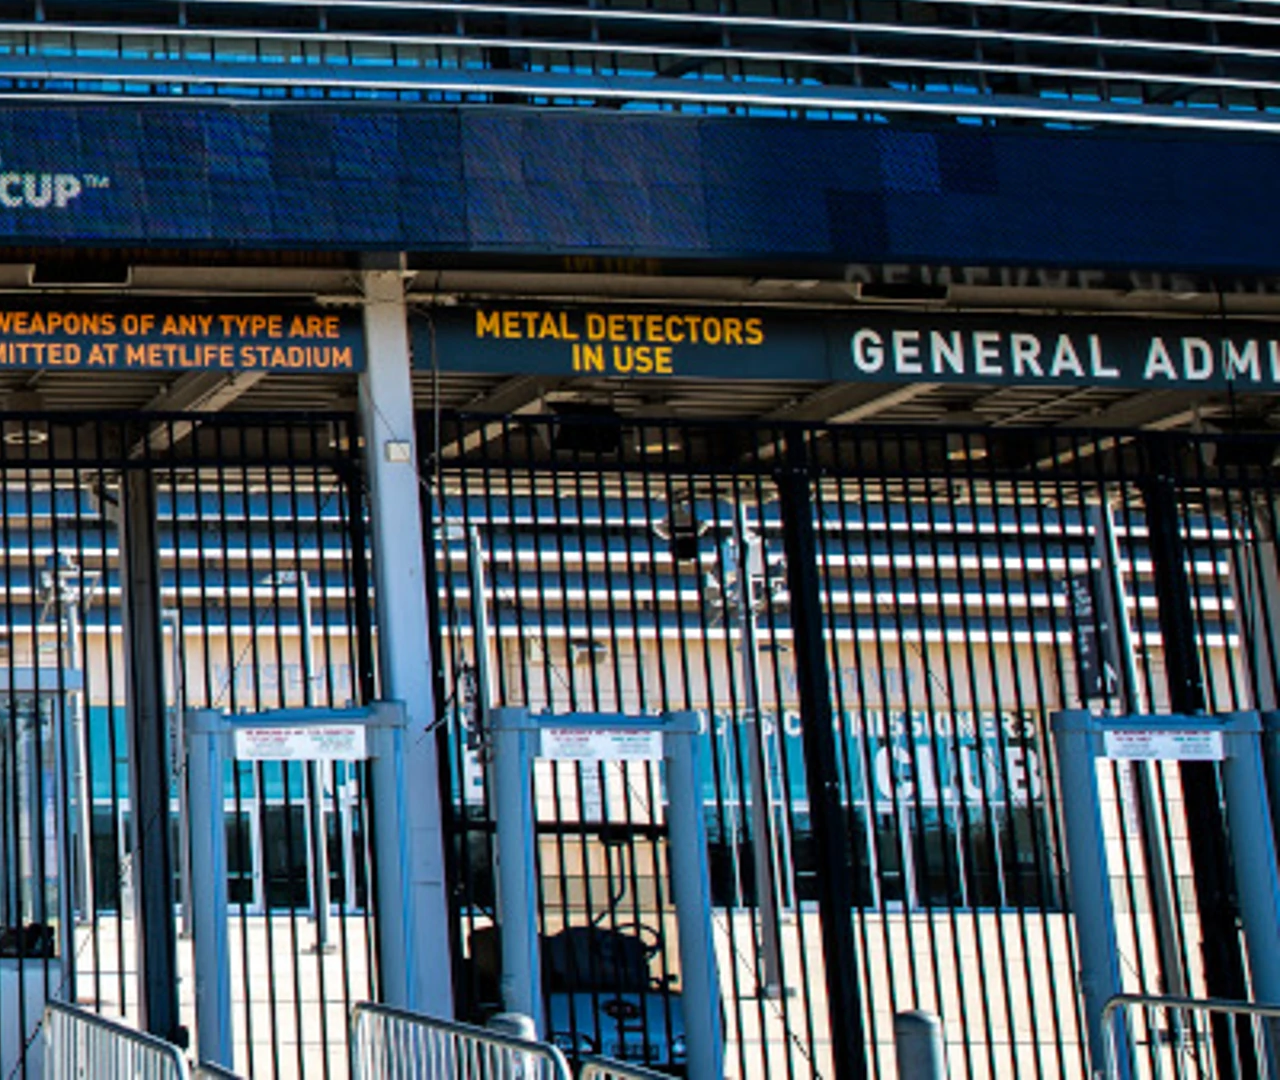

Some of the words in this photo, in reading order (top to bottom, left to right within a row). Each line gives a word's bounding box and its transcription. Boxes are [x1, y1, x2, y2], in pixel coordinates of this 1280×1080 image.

[122, 312, 155, 336] OF
[160, 313, 214, 337] ANY
[218, 314, 283, 338] TYPE
[288, 316, 341, 339] ARE
[475, 309, 580, 340] METAL
[585, 313, 765, 346] DETECTORS
[87, 342, 119, 366] AT
[126, 343, 236, 367] METLIFE
[239, 345, 354, 368] STADIUM
[571, 343, 605, 372] IN
[612, 345, 674, 374] USE
[851, 328, 1121, 379] GENERAL
[877, 744, 1044, 802] CLUB
